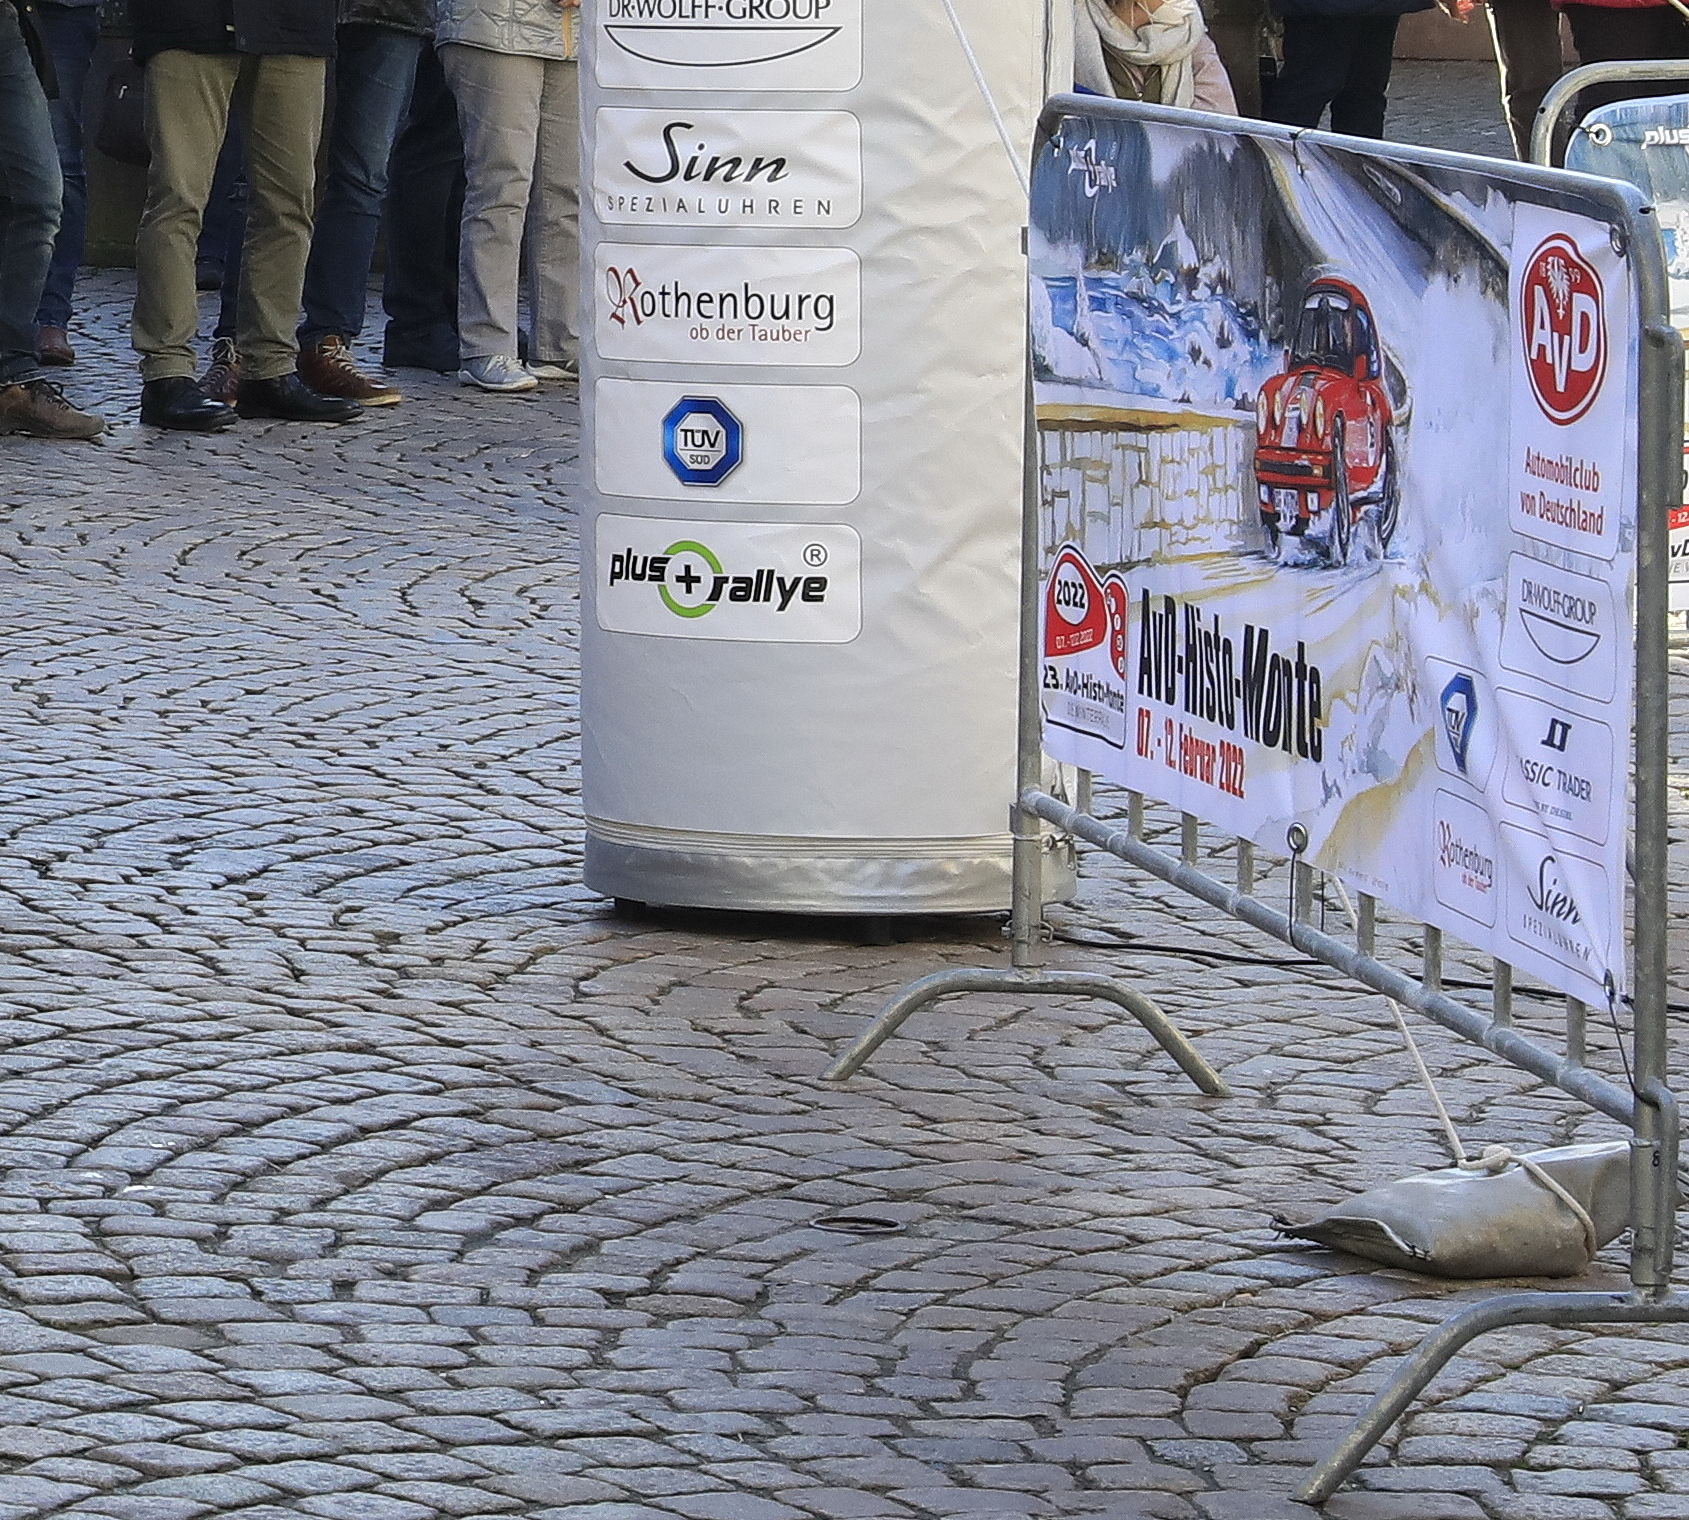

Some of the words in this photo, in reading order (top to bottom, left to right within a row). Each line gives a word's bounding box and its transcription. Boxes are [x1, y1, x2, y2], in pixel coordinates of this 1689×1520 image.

[623, 121, 791, 184] Sinn
[607, 195, 832, 216] SPEZIALUHREN
[605, 265, 836, 332] Rothenburg
[689, 324, 711, 341] ob
[715, 324, 743, 342] der
[748, 323, 812, 344] Tauber
[679, 427, 721, 450] TÜV
[1524, 445, 1601, 494] Automobilclub
[1520, 489, 1536, 514] von
[1538, 490, 1605, 536] Deutschland
[1055, 578, 1086, 610] 2022
[1137, 586, 1323, 764] AvD-Histo-Monte
[1179, 722, 1216, 785] Februar
[1218, 738, 1245, 800] 2022
[1556, 768, 1593, 803] TRADER
